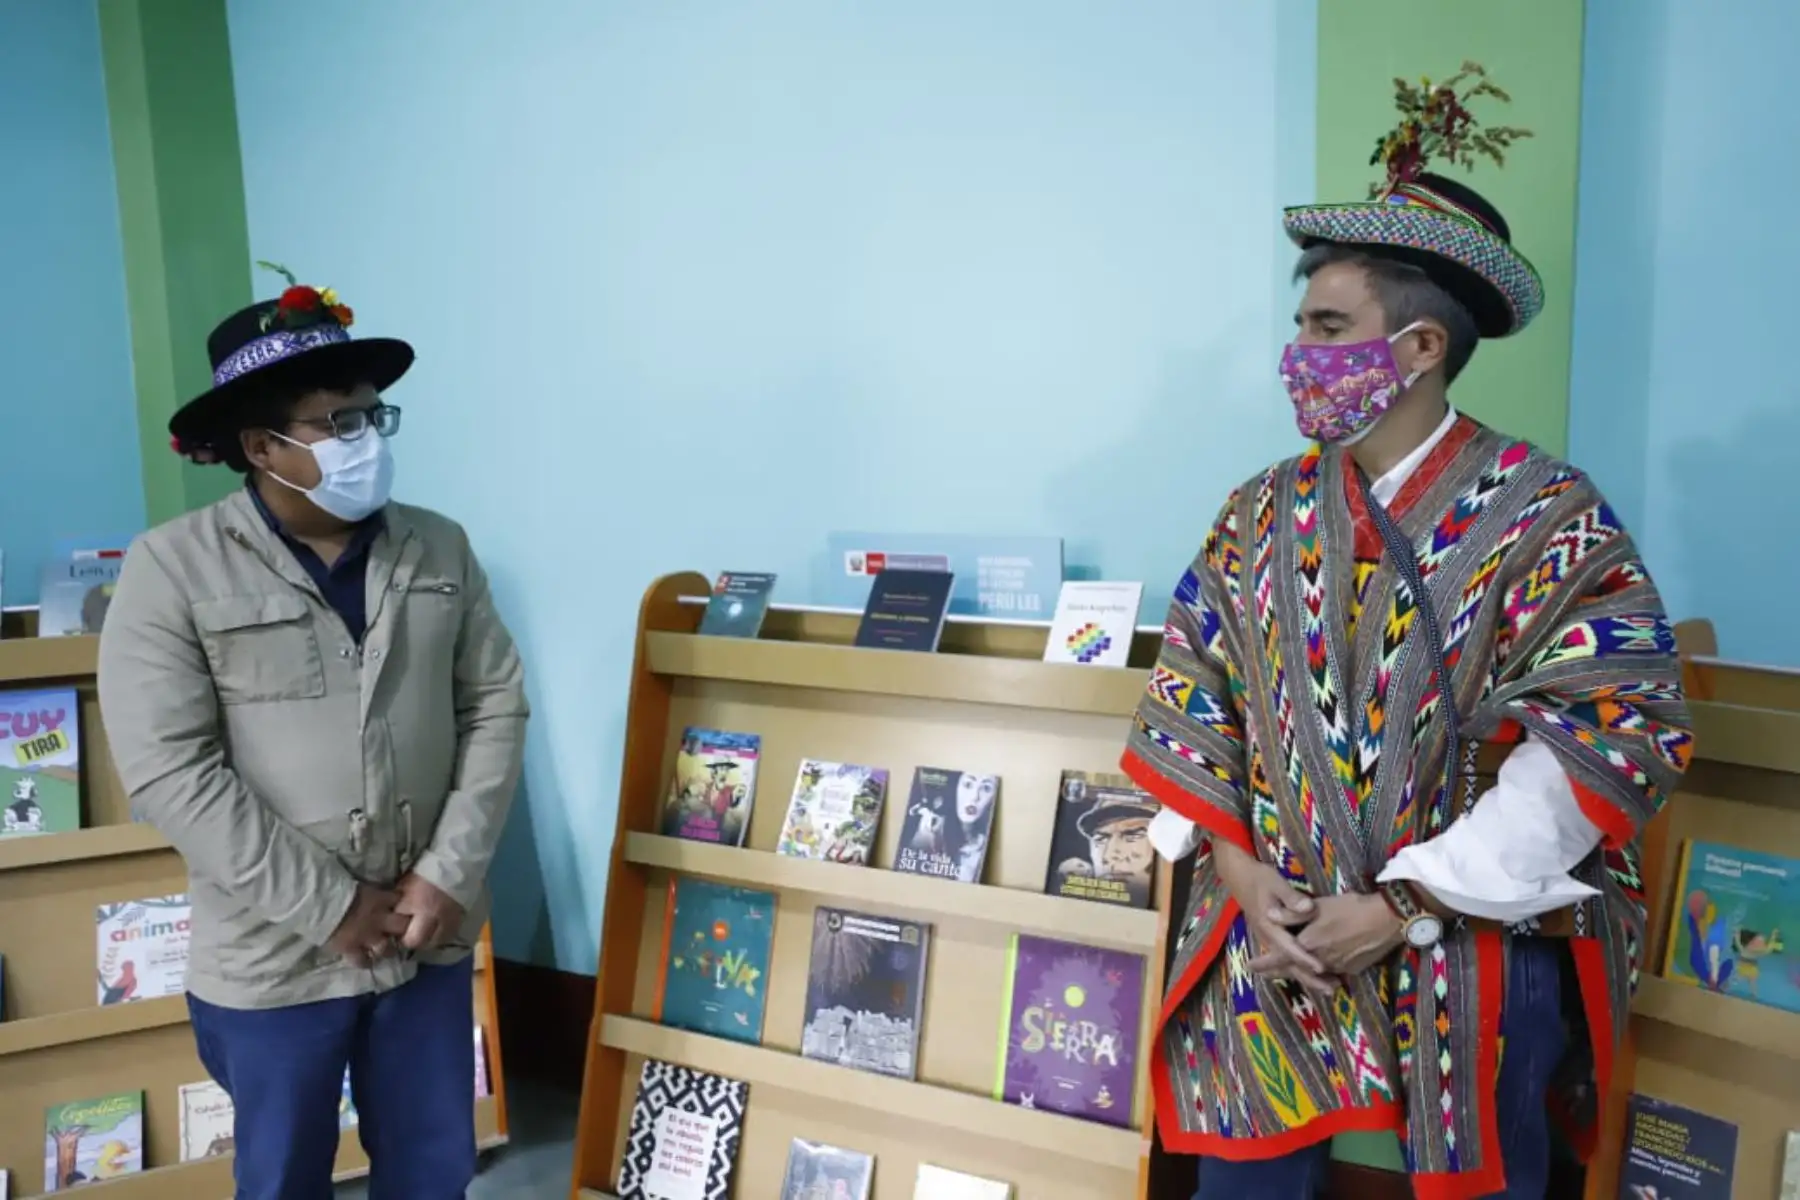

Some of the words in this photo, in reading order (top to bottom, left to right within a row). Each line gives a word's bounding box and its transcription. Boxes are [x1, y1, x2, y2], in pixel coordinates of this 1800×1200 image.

[20, 733, 61, 760] TIRA
[902, 847, 917, 859] De
[899, 858, 916, 871] su
[1021, 1005, 1117, 1066] SIERRA
